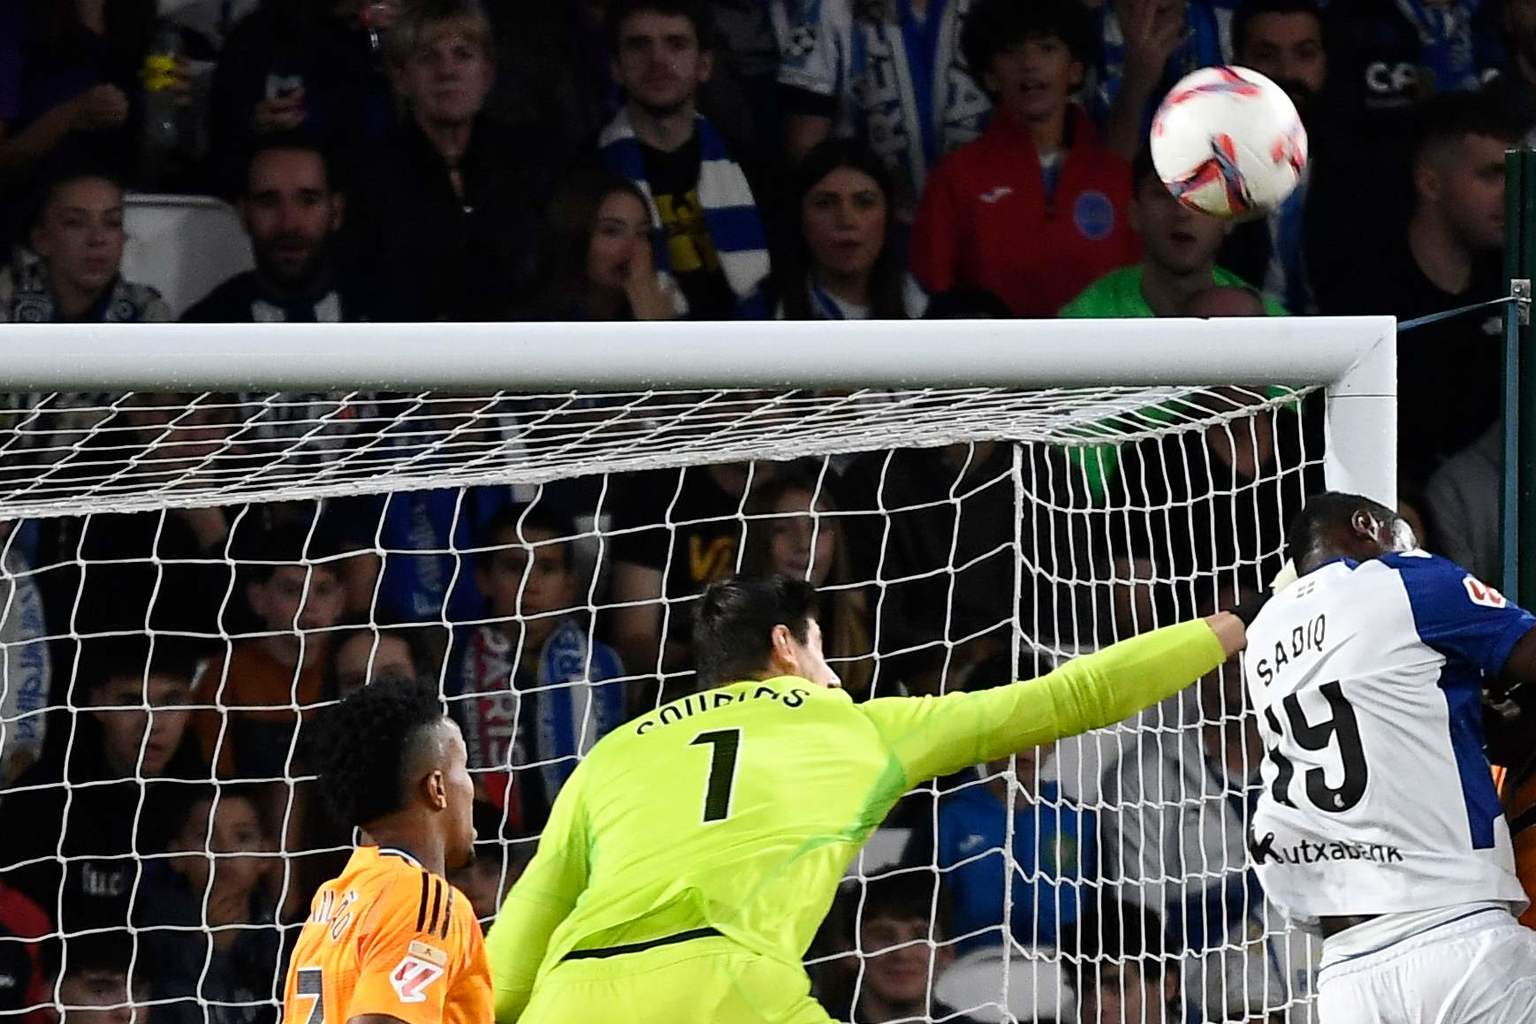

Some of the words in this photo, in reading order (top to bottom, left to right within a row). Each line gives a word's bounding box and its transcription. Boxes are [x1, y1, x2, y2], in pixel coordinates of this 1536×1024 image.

[1256, 613, 1326, 688] SADIQ
[688, 728, 741, 823] 1
[1263, 679, 1369, 814] 19
